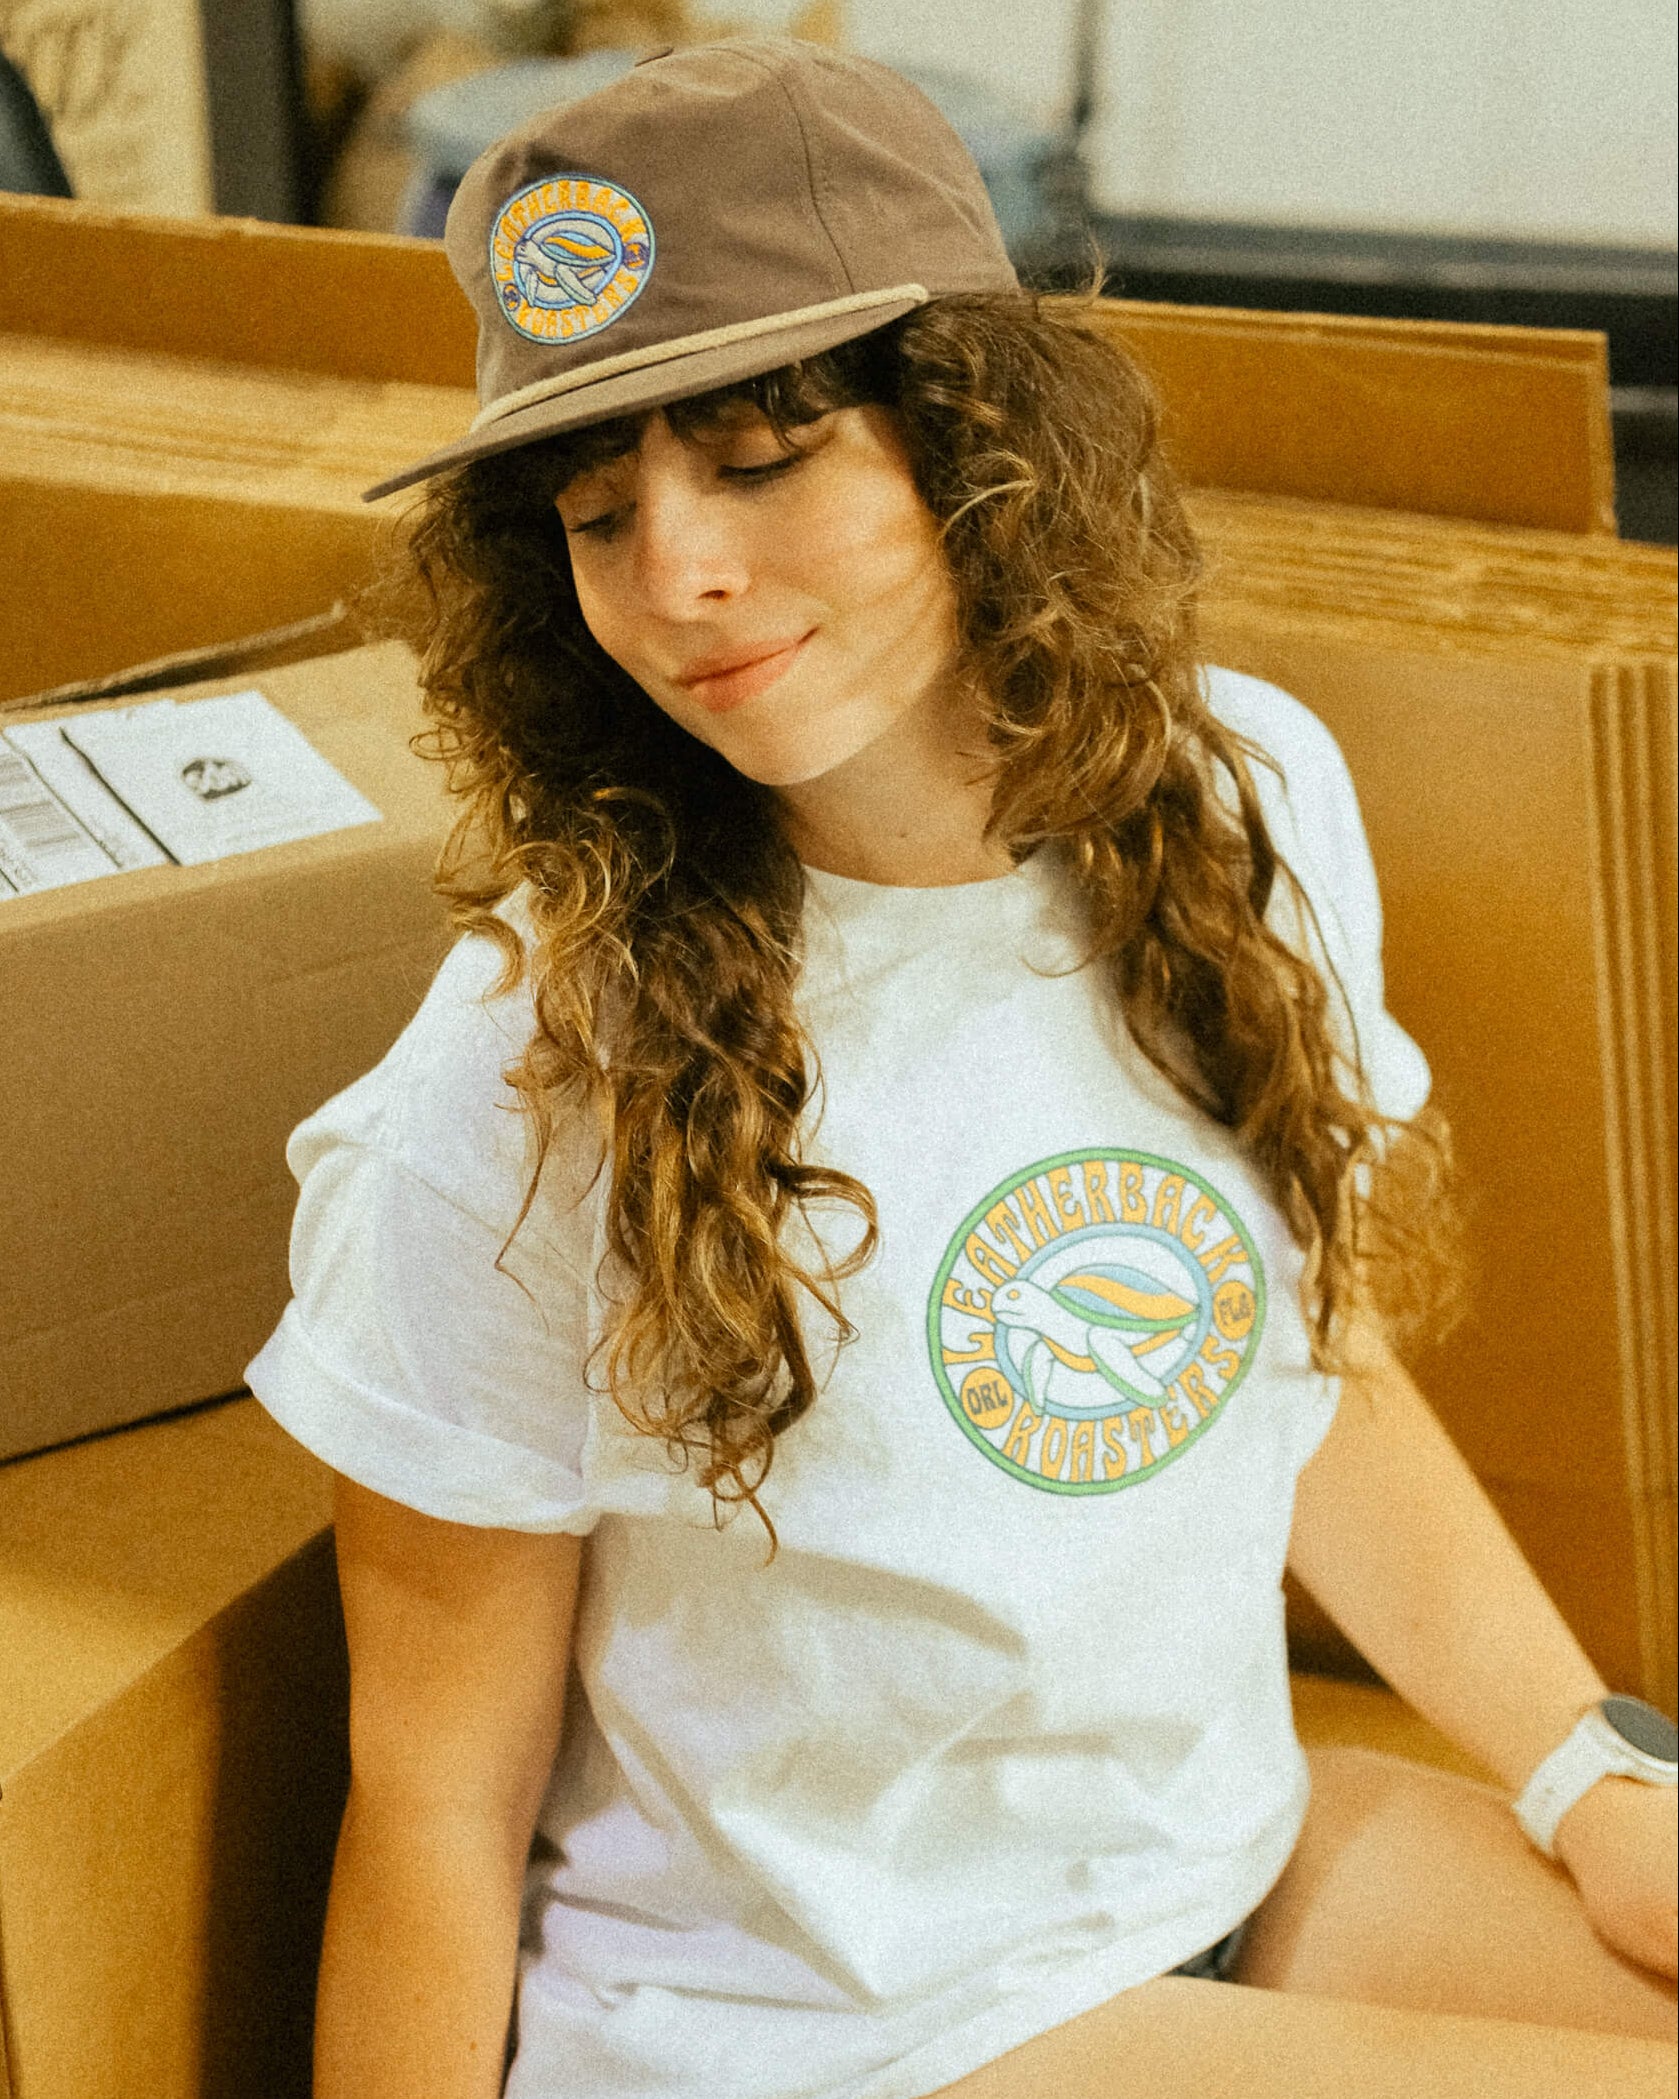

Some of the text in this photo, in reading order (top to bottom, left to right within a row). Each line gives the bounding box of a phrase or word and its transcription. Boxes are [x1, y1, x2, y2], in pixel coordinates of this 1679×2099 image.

[494, 180, 647, 281] LEATHERBACK
[517, 269, 639, 337] ROASTERS
[941, 1160, 1249, 1366] LEATHERBACK
[966, 1380, 1009, 1416] ORL
[1000, 1335, 1241, 1483] ROASTERS
